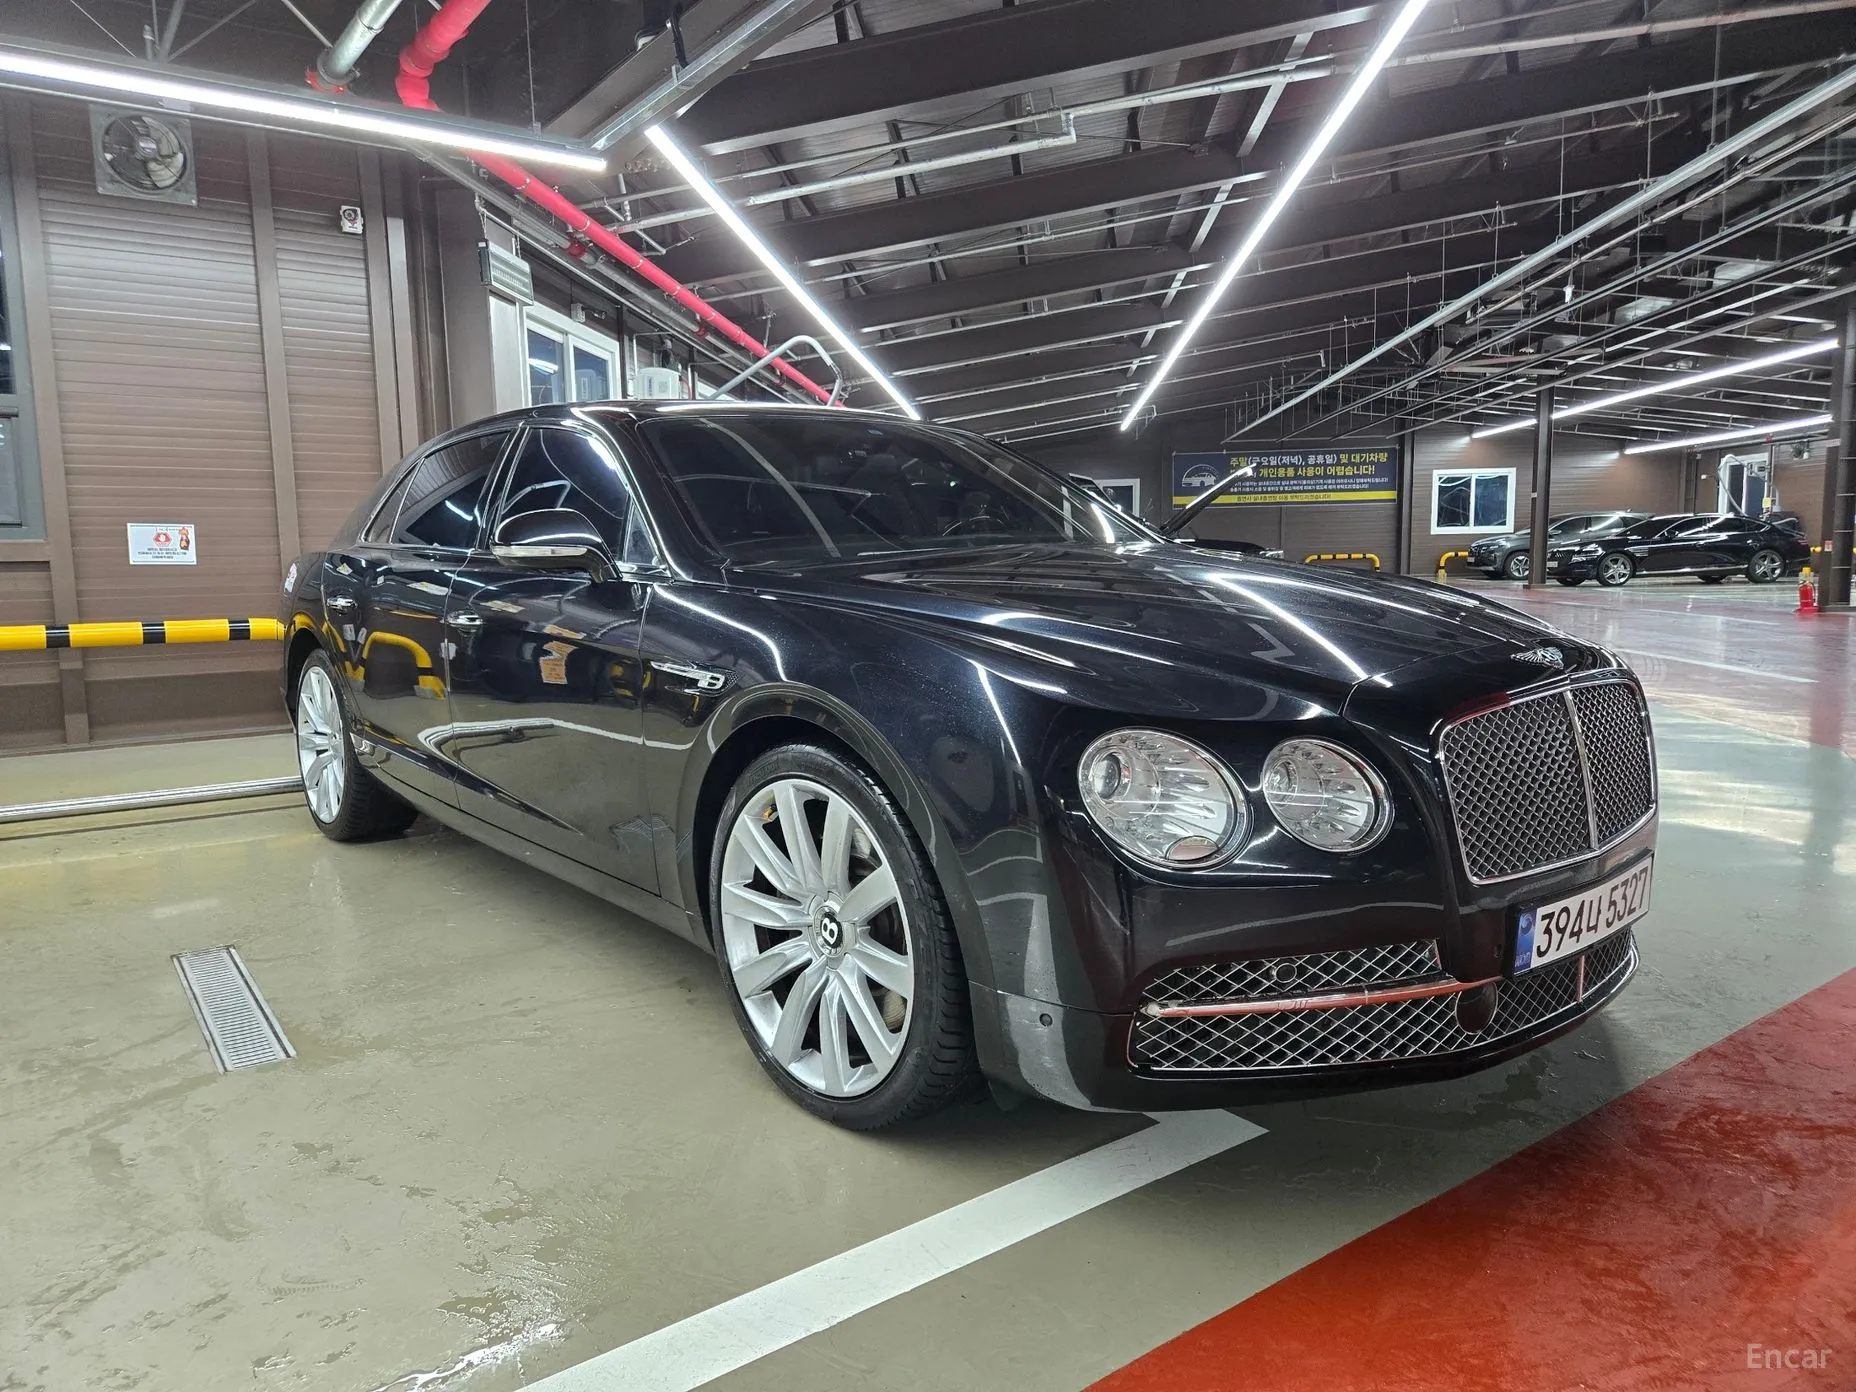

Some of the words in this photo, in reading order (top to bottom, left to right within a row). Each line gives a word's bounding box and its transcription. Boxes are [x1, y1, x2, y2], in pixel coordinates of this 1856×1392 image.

[1307, 454, 1337, 465] 공휴일)
[1340, 453, 1349, 464] 및
[1351, 452, 1389, 463] 대기차량
[1259, 467, 1295, 478] 개인용품
[1297, 466, 1324, 477] 사용이
[1326, 465, 1375, 476] 어렵습니다!
[1536, 895, 1602, 958] 394나
[1605, 866, 1649, 929] 5327
